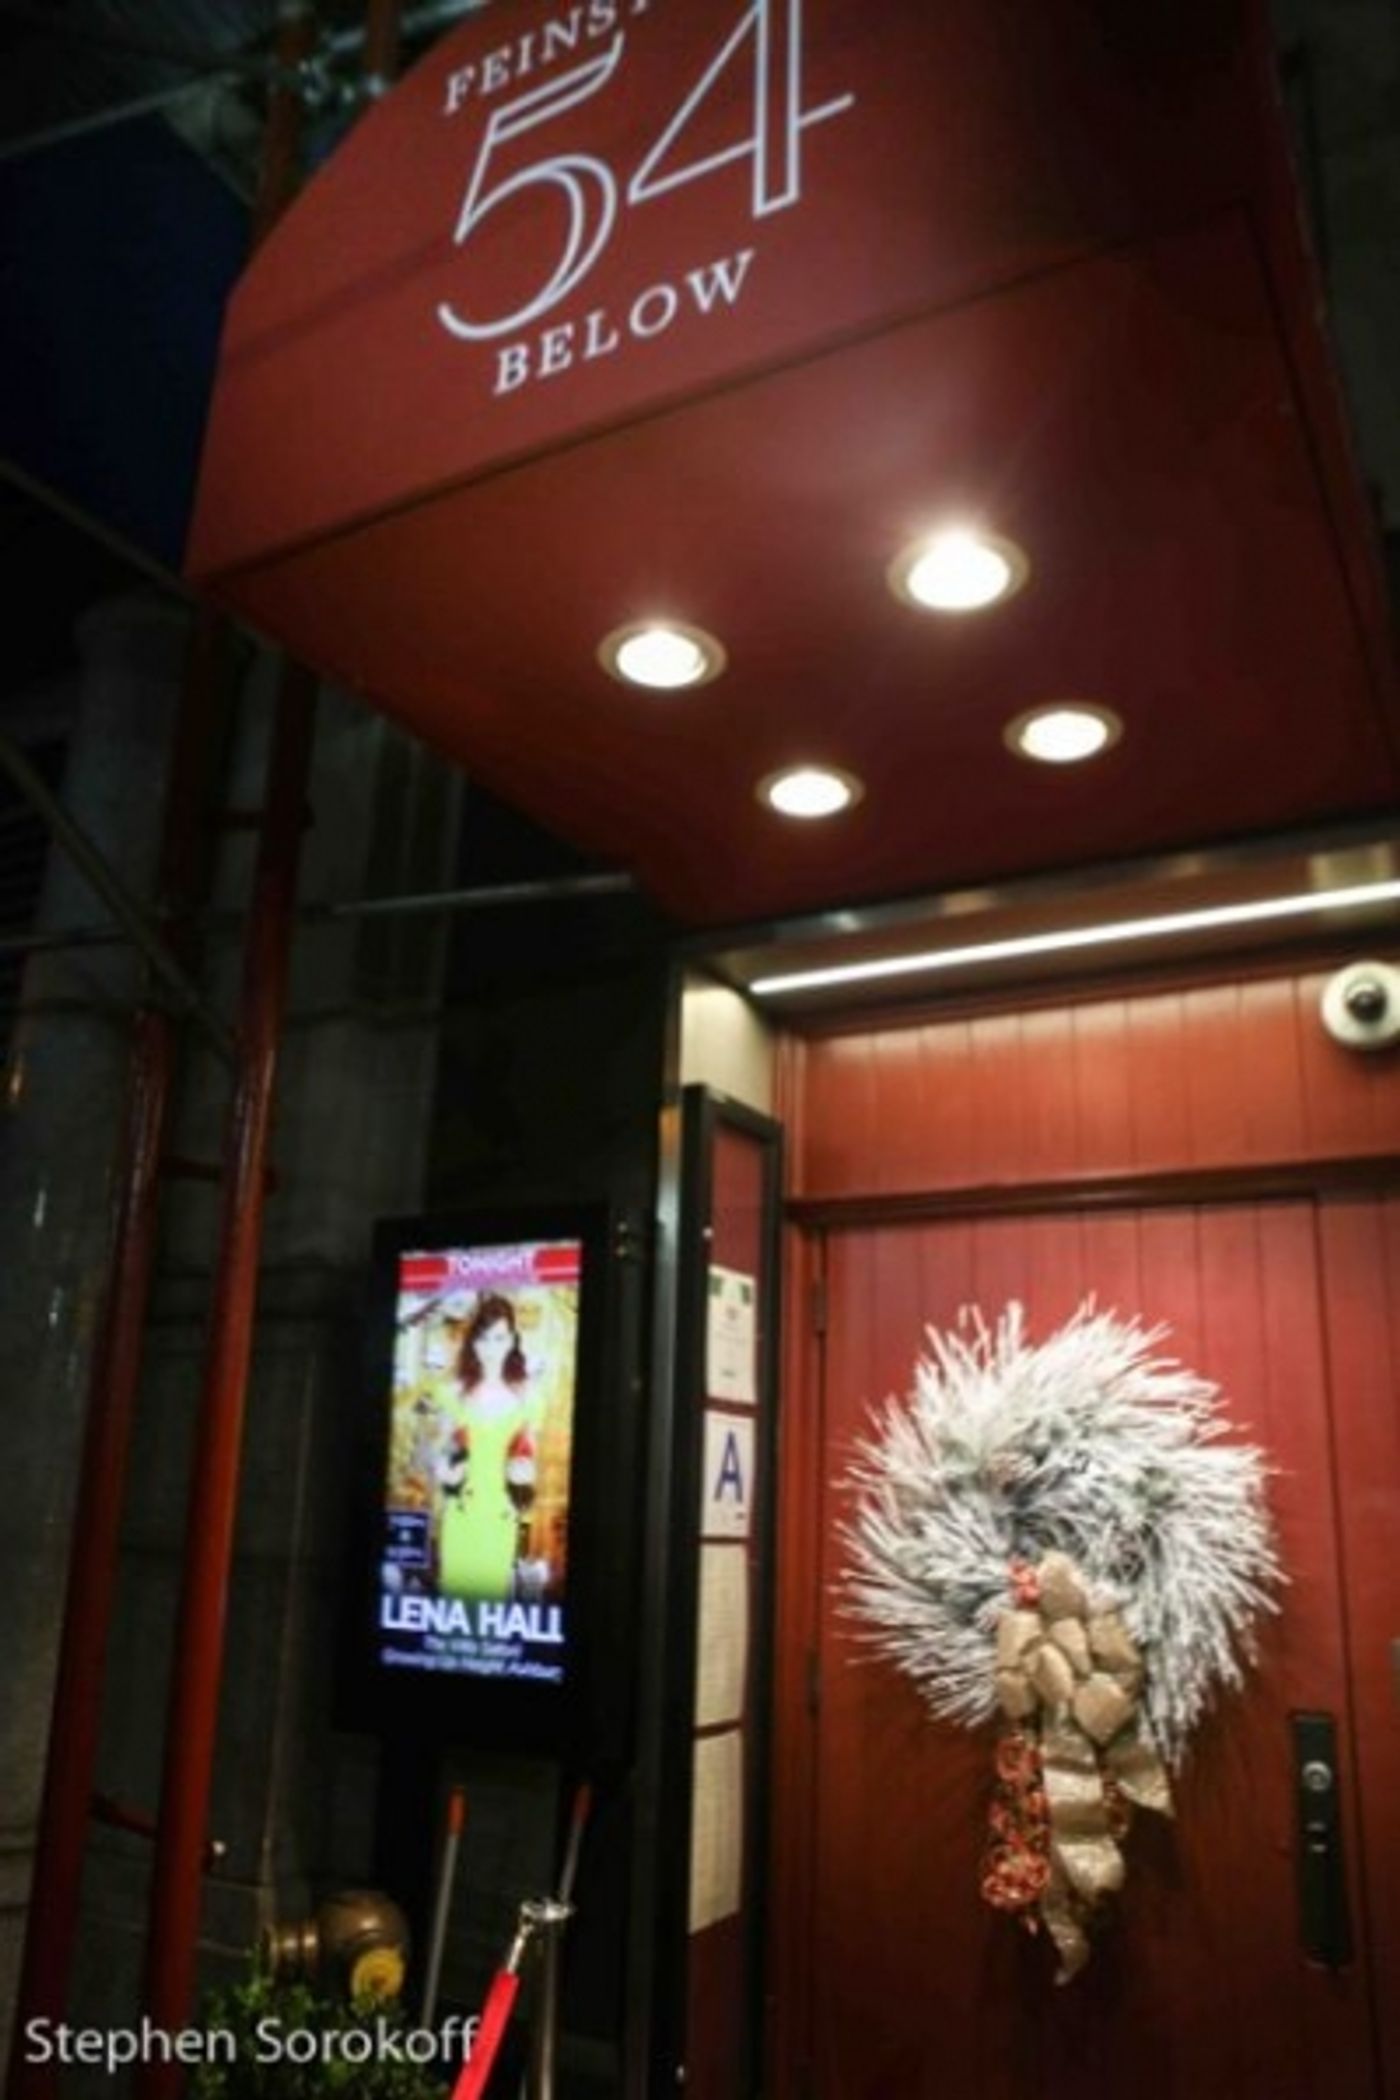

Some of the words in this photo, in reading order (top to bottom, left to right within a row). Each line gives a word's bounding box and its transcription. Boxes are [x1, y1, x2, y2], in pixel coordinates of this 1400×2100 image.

[437, 0, 855, 339] 54
[494, 248, 754, 395] BELOW
[714, 1430, 743, 1502] A
[382, 1595, 472, 1636] LENA
[477, 1602, 565, 1643] HALL
